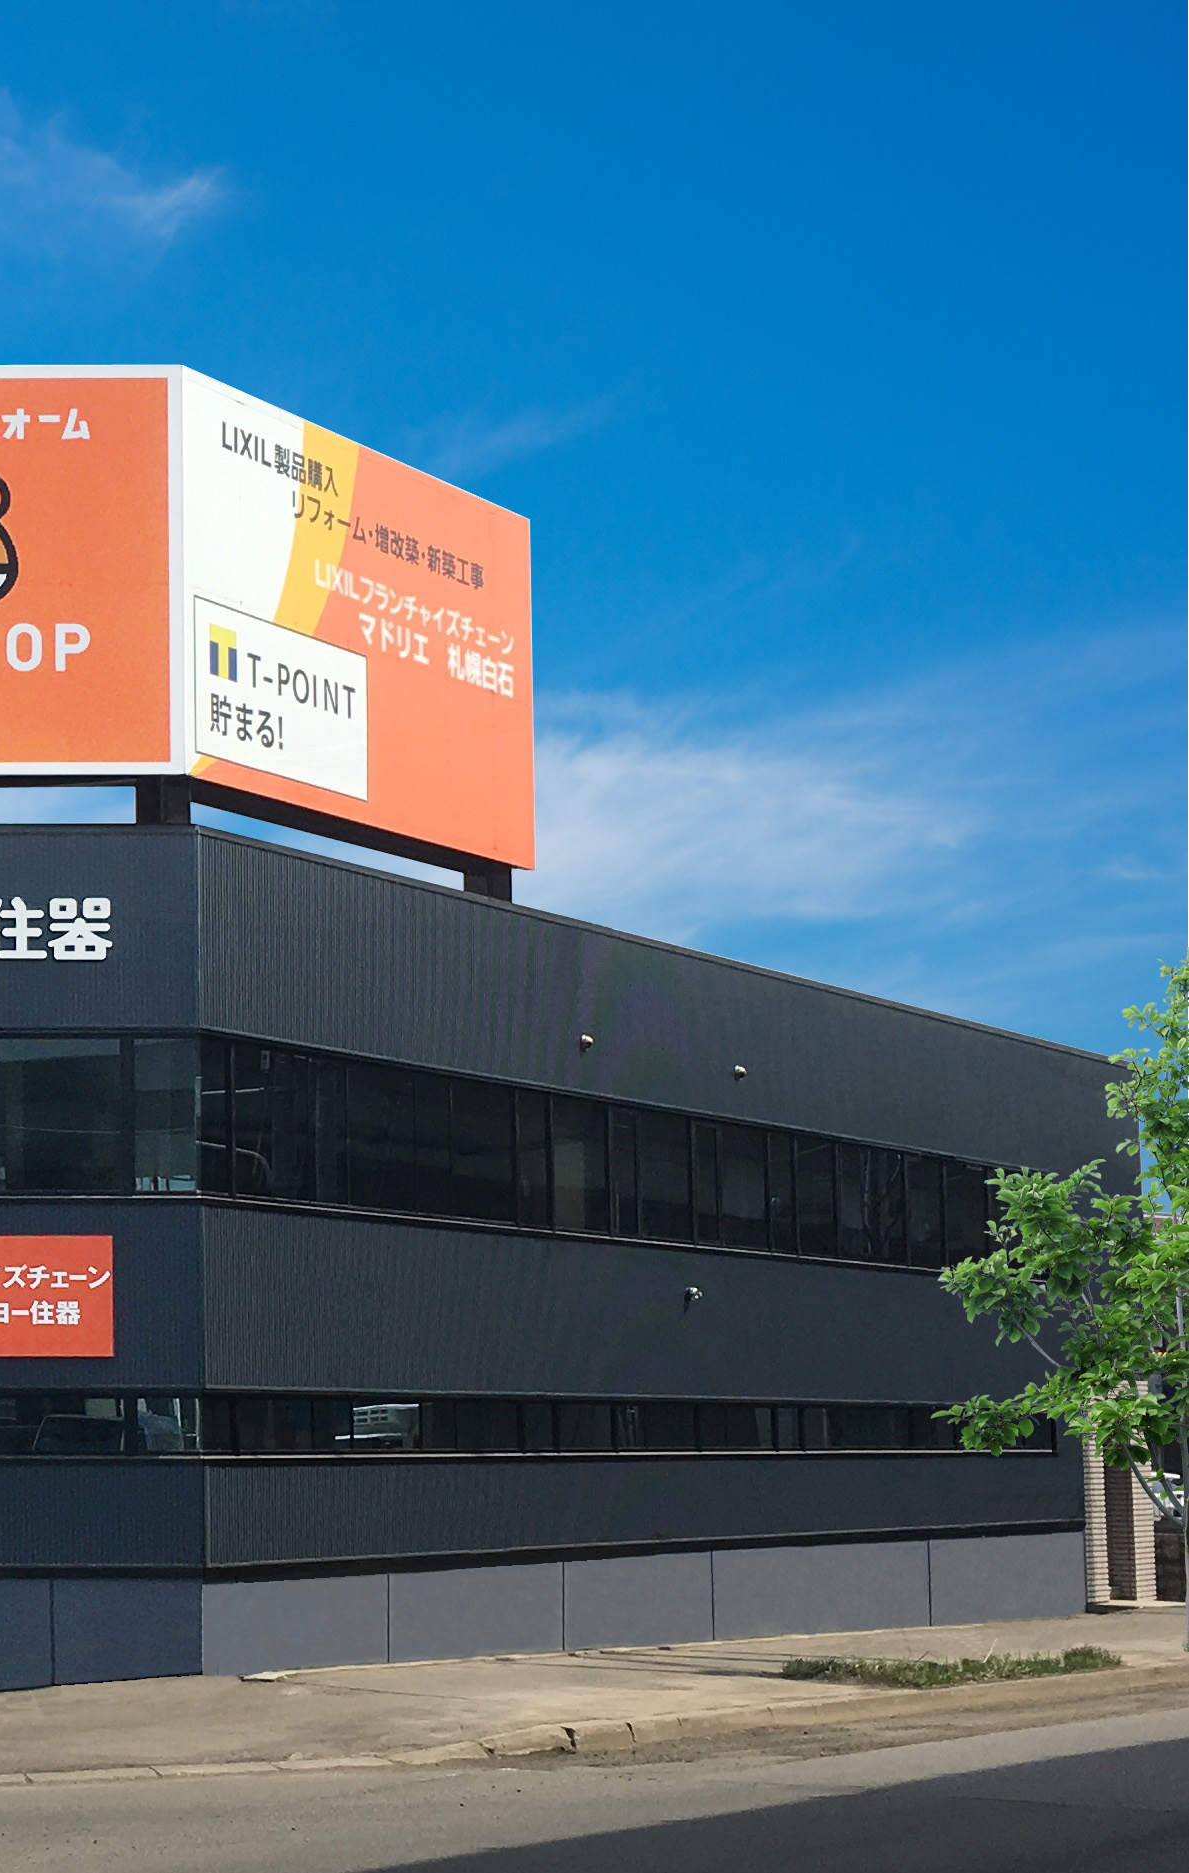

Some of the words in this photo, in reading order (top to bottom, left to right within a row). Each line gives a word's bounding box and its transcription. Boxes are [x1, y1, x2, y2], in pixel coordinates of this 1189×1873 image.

[247, 653, 355, 719] T-POINT
[359, 612, 429, 665] マドリエ
[448, 643, 514, 698] 札幌白石
